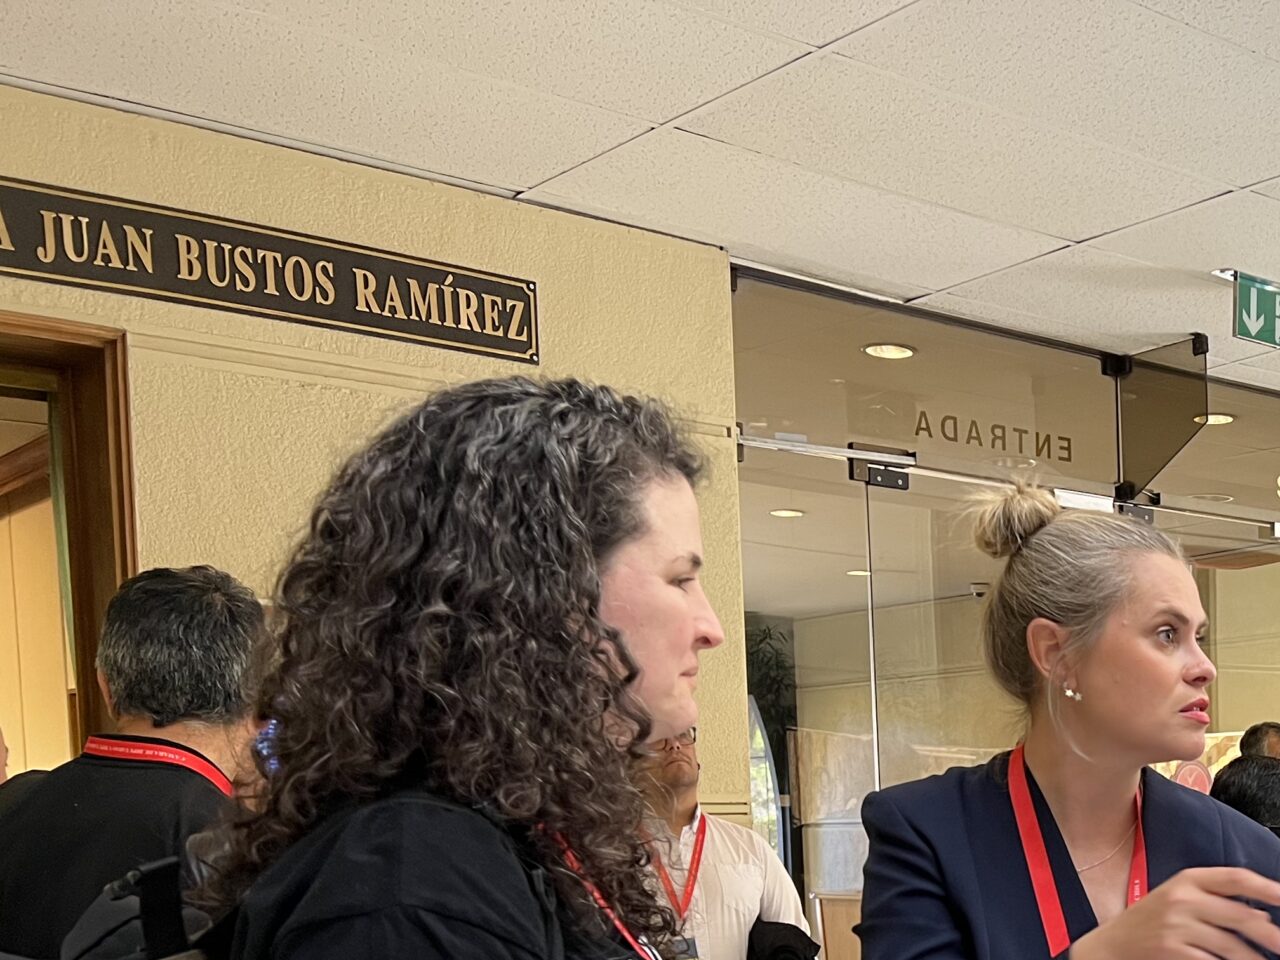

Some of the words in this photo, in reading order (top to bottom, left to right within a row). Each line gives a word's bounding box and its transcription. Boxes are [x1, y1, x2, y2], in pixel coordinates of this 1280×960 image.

[37, 210, 154, 273] JUAN
[175, 234, 336, 306] BUSTOS
[352, 268, 528, 342] RAMÍREZ
